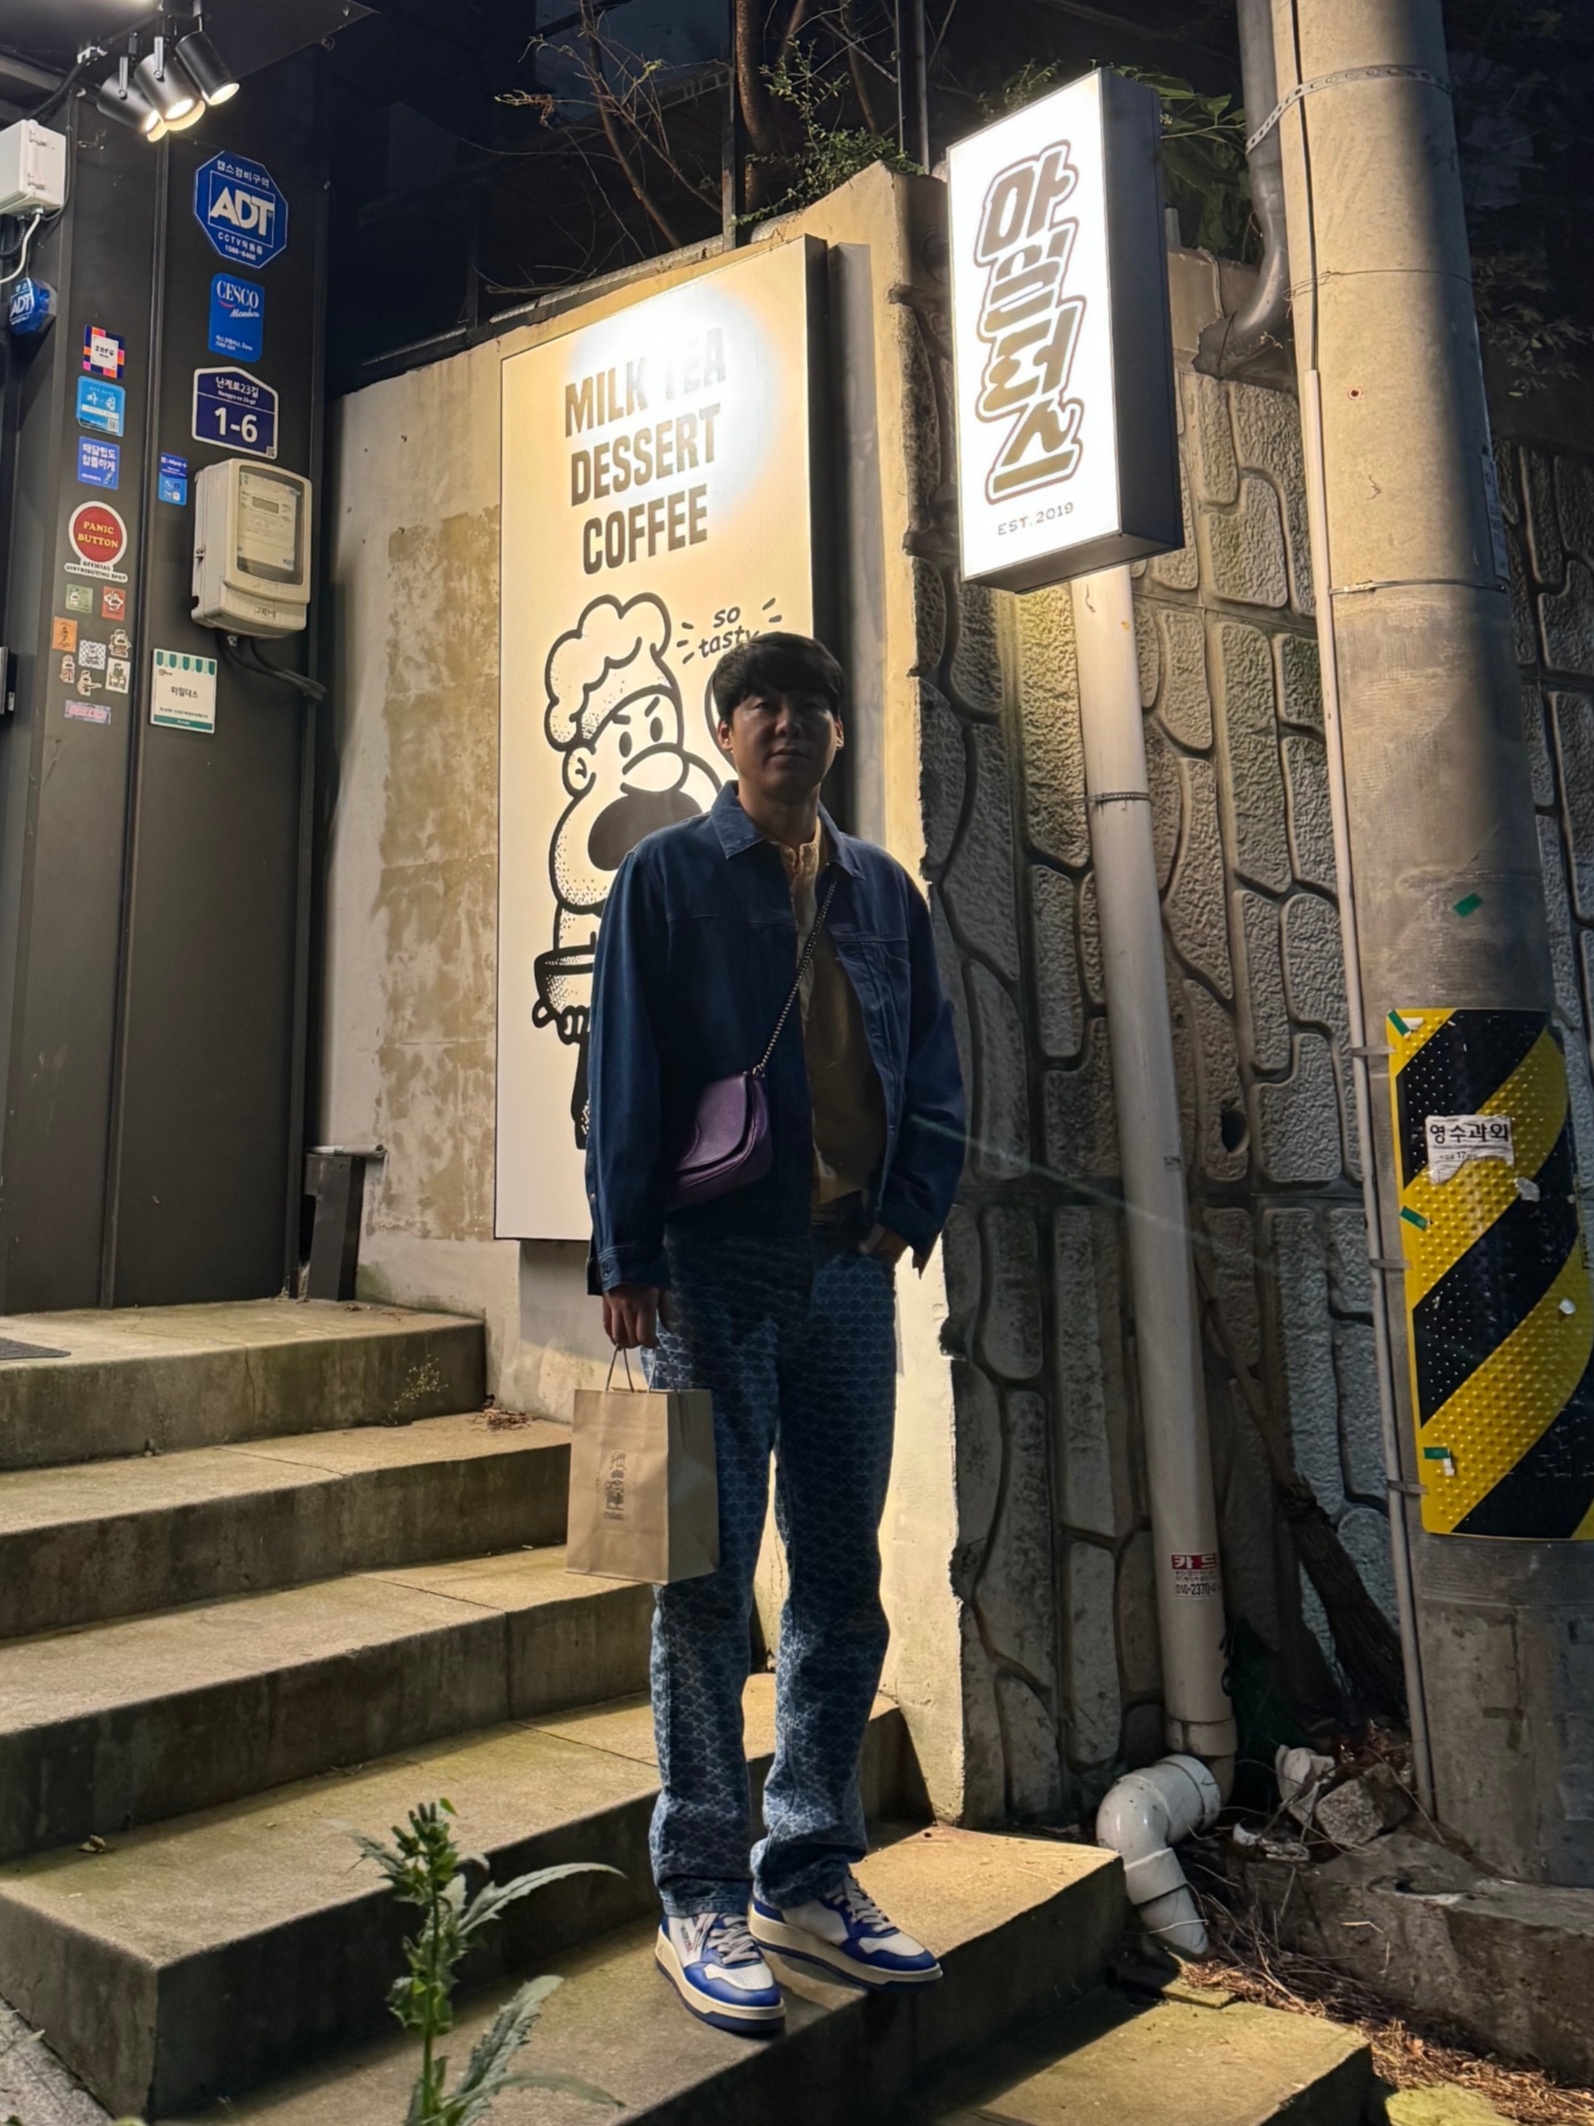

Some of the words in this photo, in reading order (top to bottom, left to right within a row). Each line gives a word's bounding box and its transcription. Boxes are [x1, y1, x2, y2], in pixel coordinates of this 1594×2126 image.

[209, 186, 275, 236] ADT
[10, 293, 32, 318] ADT
[216, 280, 260, 309] CESCO
[215, 376, 260, 399] 난계로23길
[565, 356, 648, 438] MILK
[214, 406, 258, 443] 1-6
[571, 403, 721, 508] DESSERT
[83, 521, 115, 535] PANIC
[583, 483, 708, 576] COFFEE
[78, 533, 119, 548] BUTTON
[66, 565, 111, 578] DISTRIBUTING
[82, 561, 112, 571] OFFICIAL
[713, 606, 741, 629] so
[1430, 1123, 1509, 1144] 영수과외
[1173, 1555, 1216, 1570] 카드
